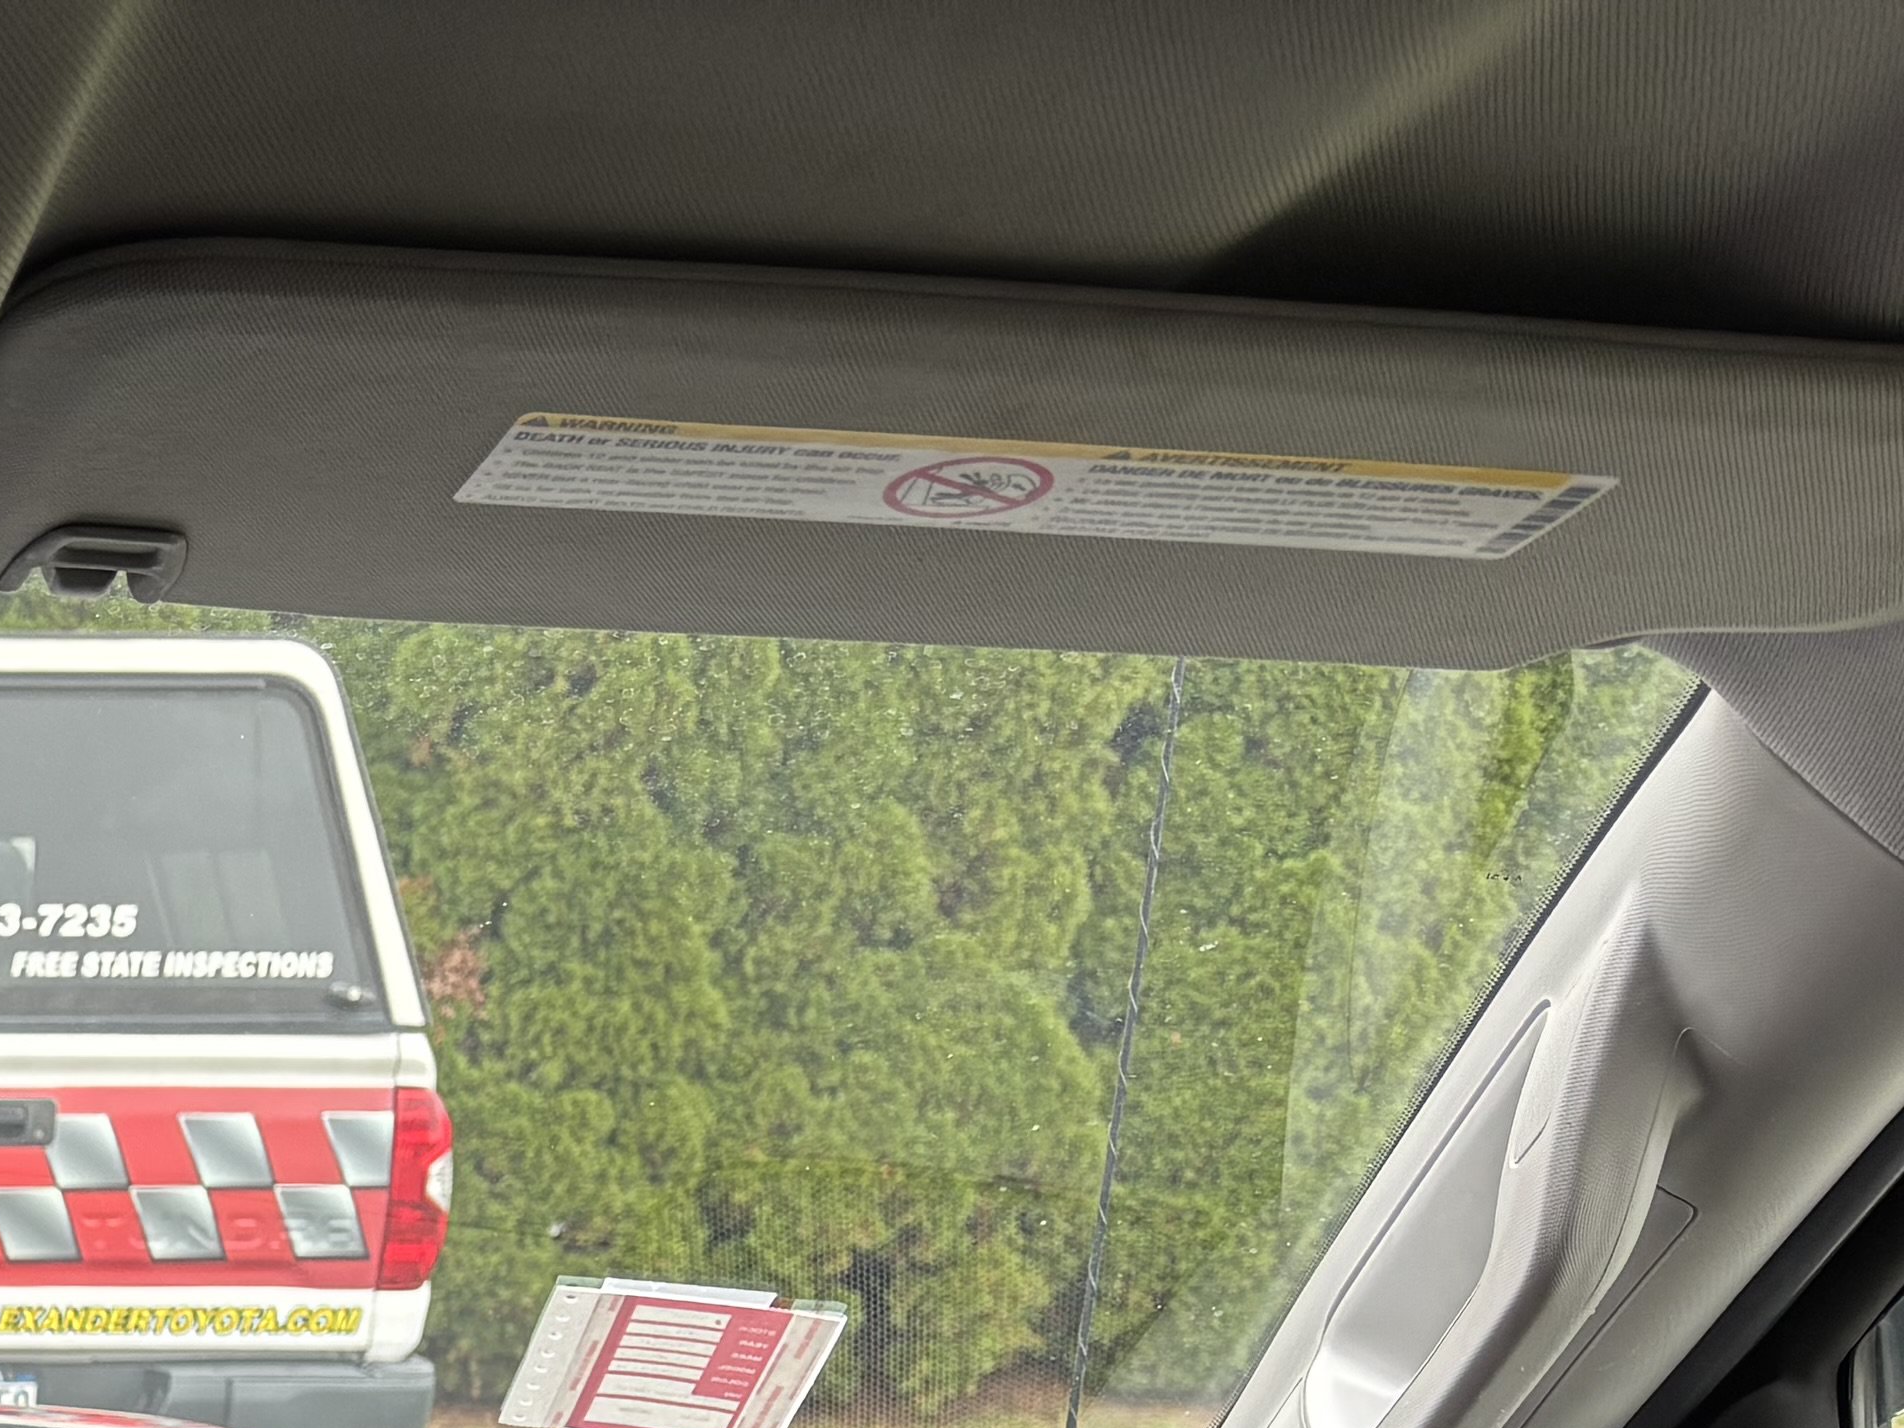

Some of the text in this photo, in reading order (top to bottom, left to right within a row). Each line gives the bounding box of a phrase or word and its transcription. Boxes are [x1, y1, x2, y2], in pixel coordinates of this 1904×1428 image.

[557, 417, 678, 434] WARNING
[512, 431, 583, 443] DEATH
[614, 437, 708, 450] SERIOUS
[711, 443, 790, 455] INJURY
[793, 449, 834, 457] can
[1089, 465, 1176, 476] DANGER
[1210, 472, 1271, 482] MORT
[11, 952, 334, 980] FREE STATE INSPECTIONS
